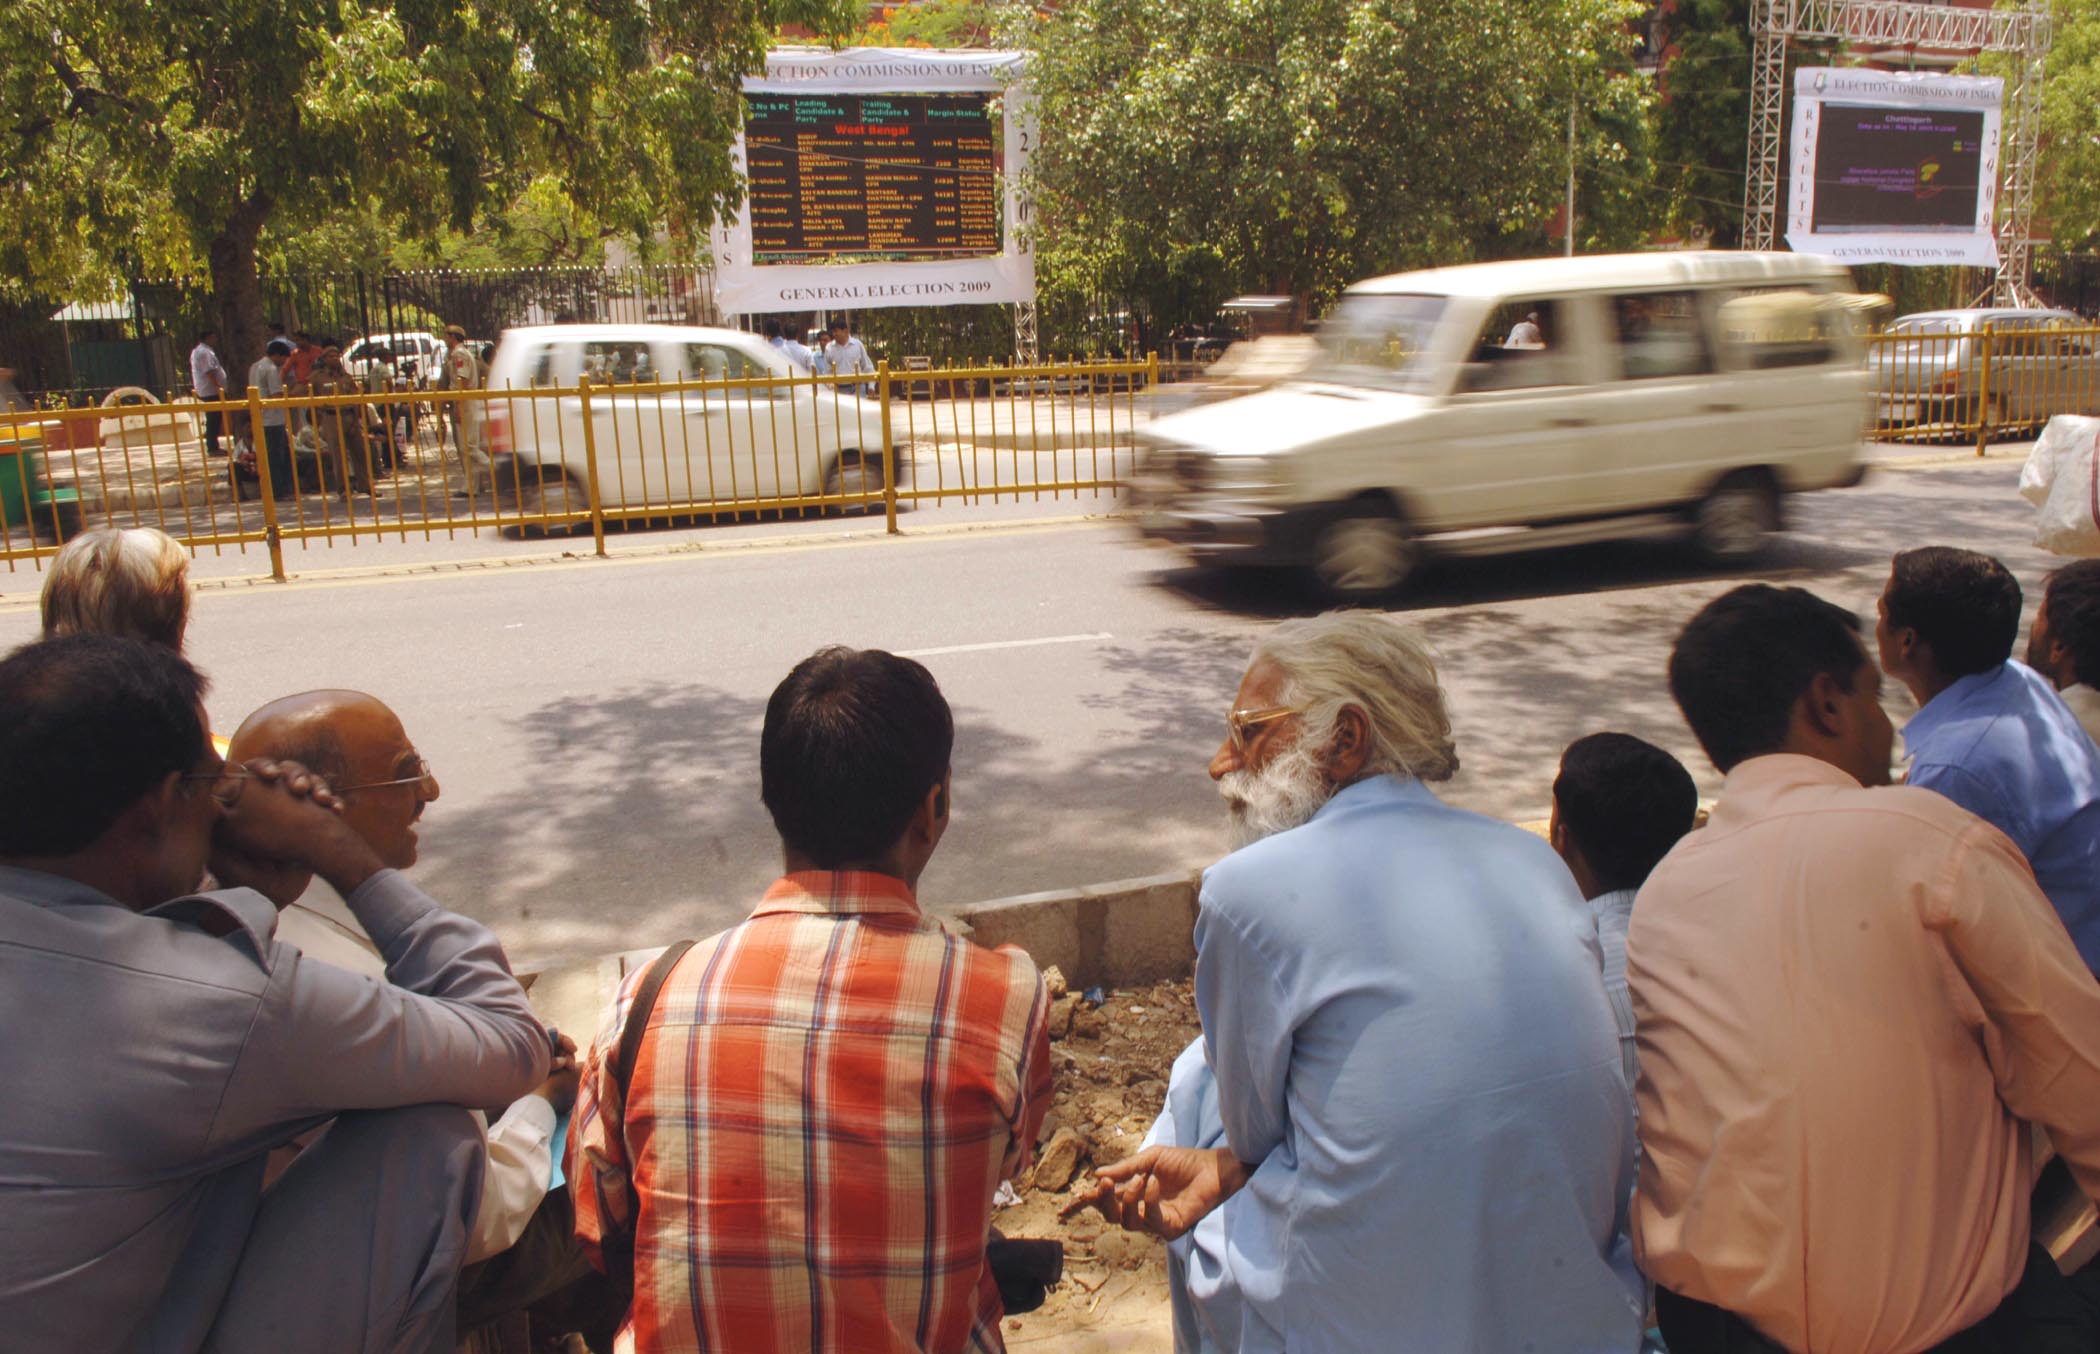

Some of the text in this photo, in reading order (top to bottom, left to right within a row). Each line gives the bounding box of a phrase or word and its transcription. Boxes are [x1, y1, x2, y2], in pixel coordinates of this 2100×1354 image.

[766, 65, 828, 78] ECTION
[833, 64, 941, 77] COMMISSION
[946, 63, 968, 76] OF
[1834, 79, 1997, 100] ELECTION COMMISSION OF INDIA
[779, 103, 789, 111] PC
[795, 99, 827, 108] Leading
[862, 100, 892, 109] Trailing
[795, 107, 836, 116] Candidate
[862, 108, 903, 117] Candidate
[927, 109, 954, 118] Margin
[956, 109, 981, 117] Status
[796, 116, 817, 124] Party
[862, 116, 884, 124] Party
[835, 124, 909, 136] West Bengal
[1796, 108, 1813, 230] RESULTS
[1983, 129, 1997, 226] 2009
[1833, 247, 1965, 258] GENERAL ELECTION 2009
[780, 280, 992, 301] GENERAL ELECTION 2009
